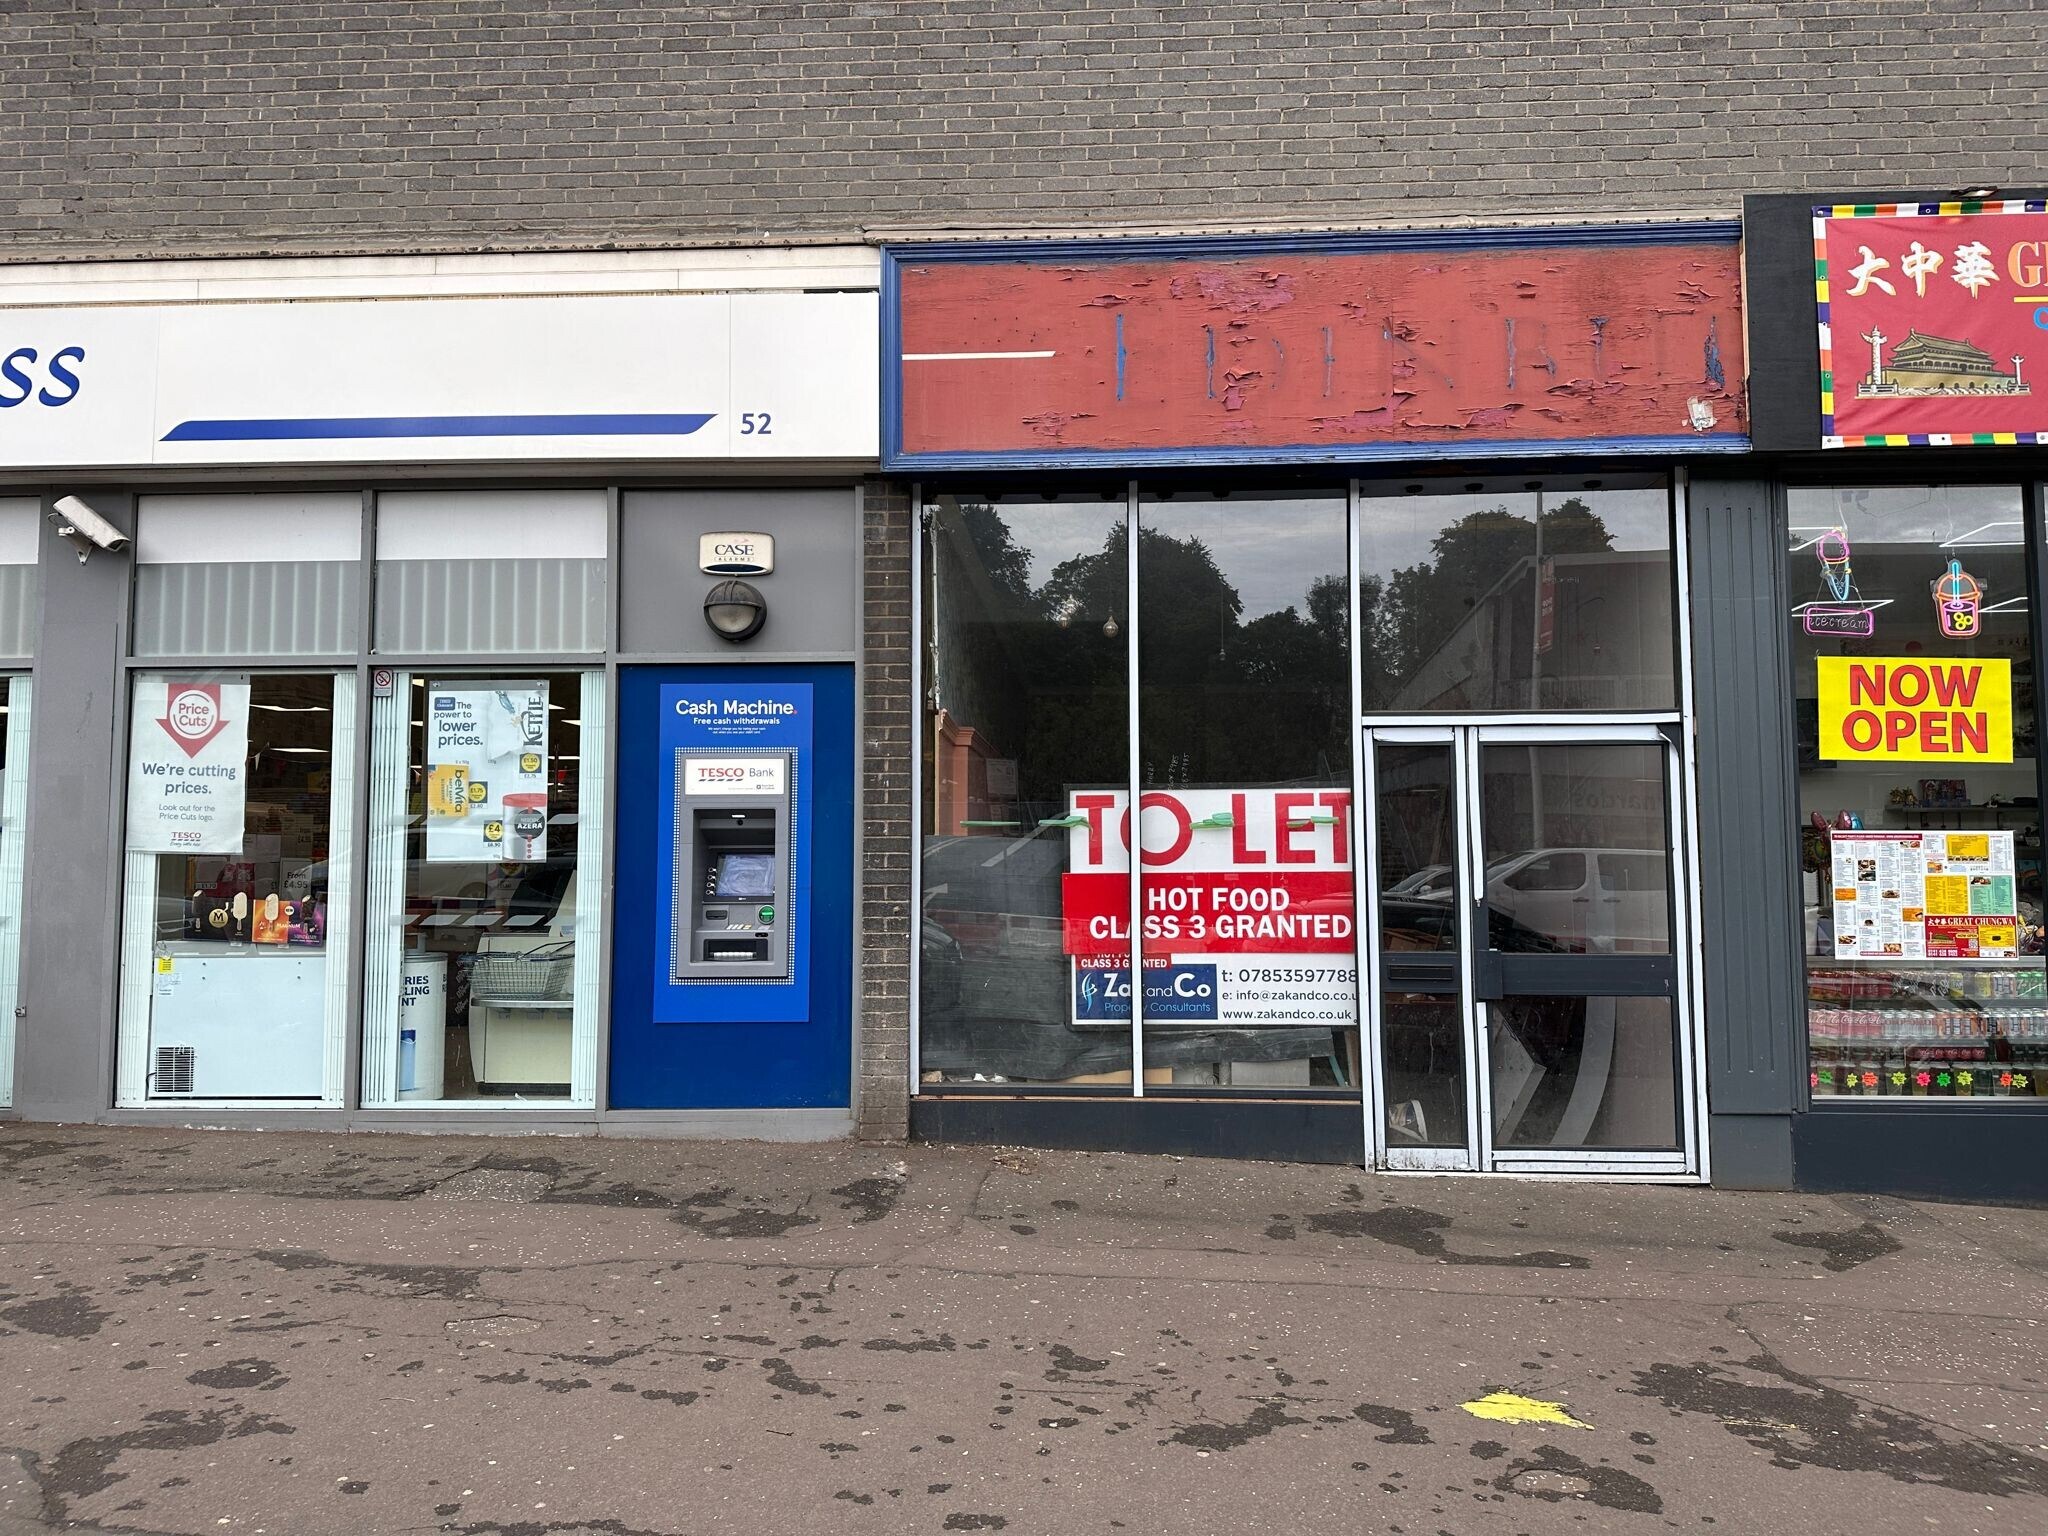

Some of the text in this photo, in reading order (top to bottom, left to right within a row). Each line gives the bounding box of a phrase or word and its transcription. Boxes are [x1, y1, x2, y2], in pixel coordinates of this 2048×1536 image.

[1845, 240, 2001, 299] 大中華
[2007, 240, 2048, 288] G
[740, 412, 772, 435] 52
[714, 544, 754, 556] CASE
[1849, 665, 1982, 707] NOW
[178, 703, 209, 715] Price
[675, 700, 717, 715] Cash
[179, 715, 207, 727] Cuts
[434, 712, 461, 720] power
[520, 697, 543, 746] KETTLE
[693, 717, 780, 725] Free cash withdrawals
[439, 720, 477, 732] lower
[1842, 710, 1988, 753] OPEN
[438, 733, 484, 749] prices.
[142, 762, 236, 781] We're cutting
[697, 768, 775, 778] TESCO Bank
[165, 781, 212, 796] prices.
[455, 769, 466, 813] belVita
[180, 813, 197, 821] Cuts
[198, 814, 214, 823] logo.
[171, 831, 202, 839] TESCO
[488, 824, 501, 833] £4
[1076, 793, 1350, 866] TO LET
[1148, 888, 1290, 911] HOT FOOD
[1189, 915, 1206, 939] 3
[1215, 914, 1352, 939] GRANTED
[1947, 917, 2014, 926] GREAT CHUNGWA
[1081, 958, 1168, 968] CLASS 3 GNTED
[1222, 969, 1358, 982] t: 07853597788
[1146, 985, 1173, 997] and
[1174, 972, 1211, 998] Co
[1222, 991, 1232, 1000] e:
[1150, 1002, 1211, 1013] Consultants
[1222, 1008, 1352, 1020] www.zakandco.co.uk
